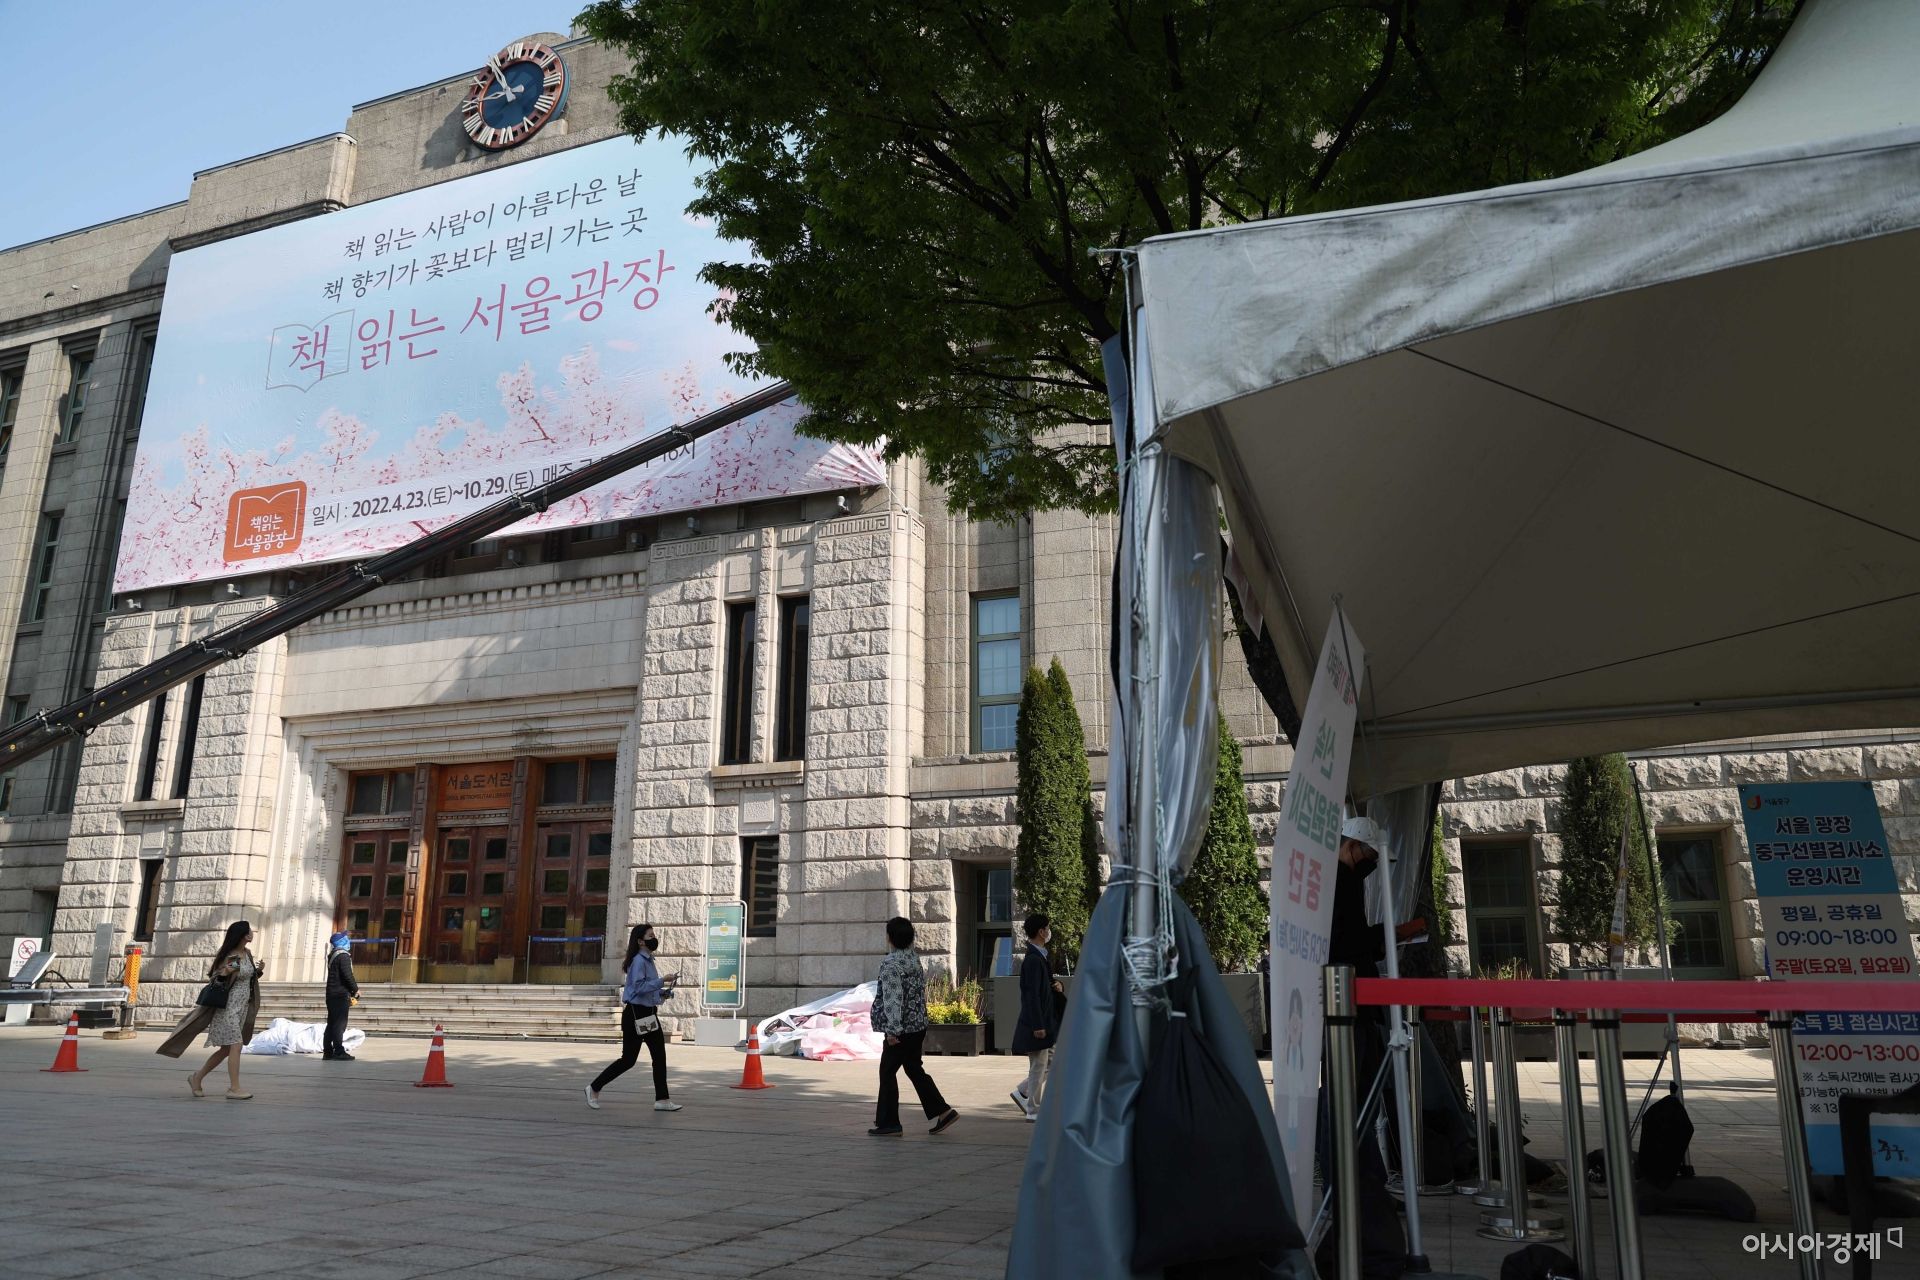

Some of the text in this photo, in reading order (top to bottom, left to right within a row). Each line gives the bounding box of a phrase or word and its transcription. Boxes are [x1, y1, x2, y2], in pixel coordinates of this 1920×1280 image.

[343, 168, 643, 262] 책 읽는 사람이 아름다운 날
[322, 207, 648, 304] 책 향기가 꽃보다 멀리 가는 곳
[288, 248, 676, 381] 책 읽는 서울광장
[250, 513, 284, 533] 책읽는
[312, 502, 340, 527] 일시
[242, 529, 288, 554] 서울광장
[447, 772, 513, 790] 서울도서관
[1776, 815, 1851, 835] 서울 광장
[1755, 841, 1883, 862] 중구선별검사소
[1787, 866, 1861, 887] 운영시간
[1780, 904, 1883, 922] 평일, 공휴일
[1776, 928, 1898, 946] 09:00~18:00
[1775, 956, 1911, 975] 주말(토요일, 일요일)
[1791, 1013, 1919, 1032] 소독 및 점심시간
[1797, 1043, 1920, 1062] 12:00~13:00
[1817, 1071, 1886, 1083] 소독시간에는
